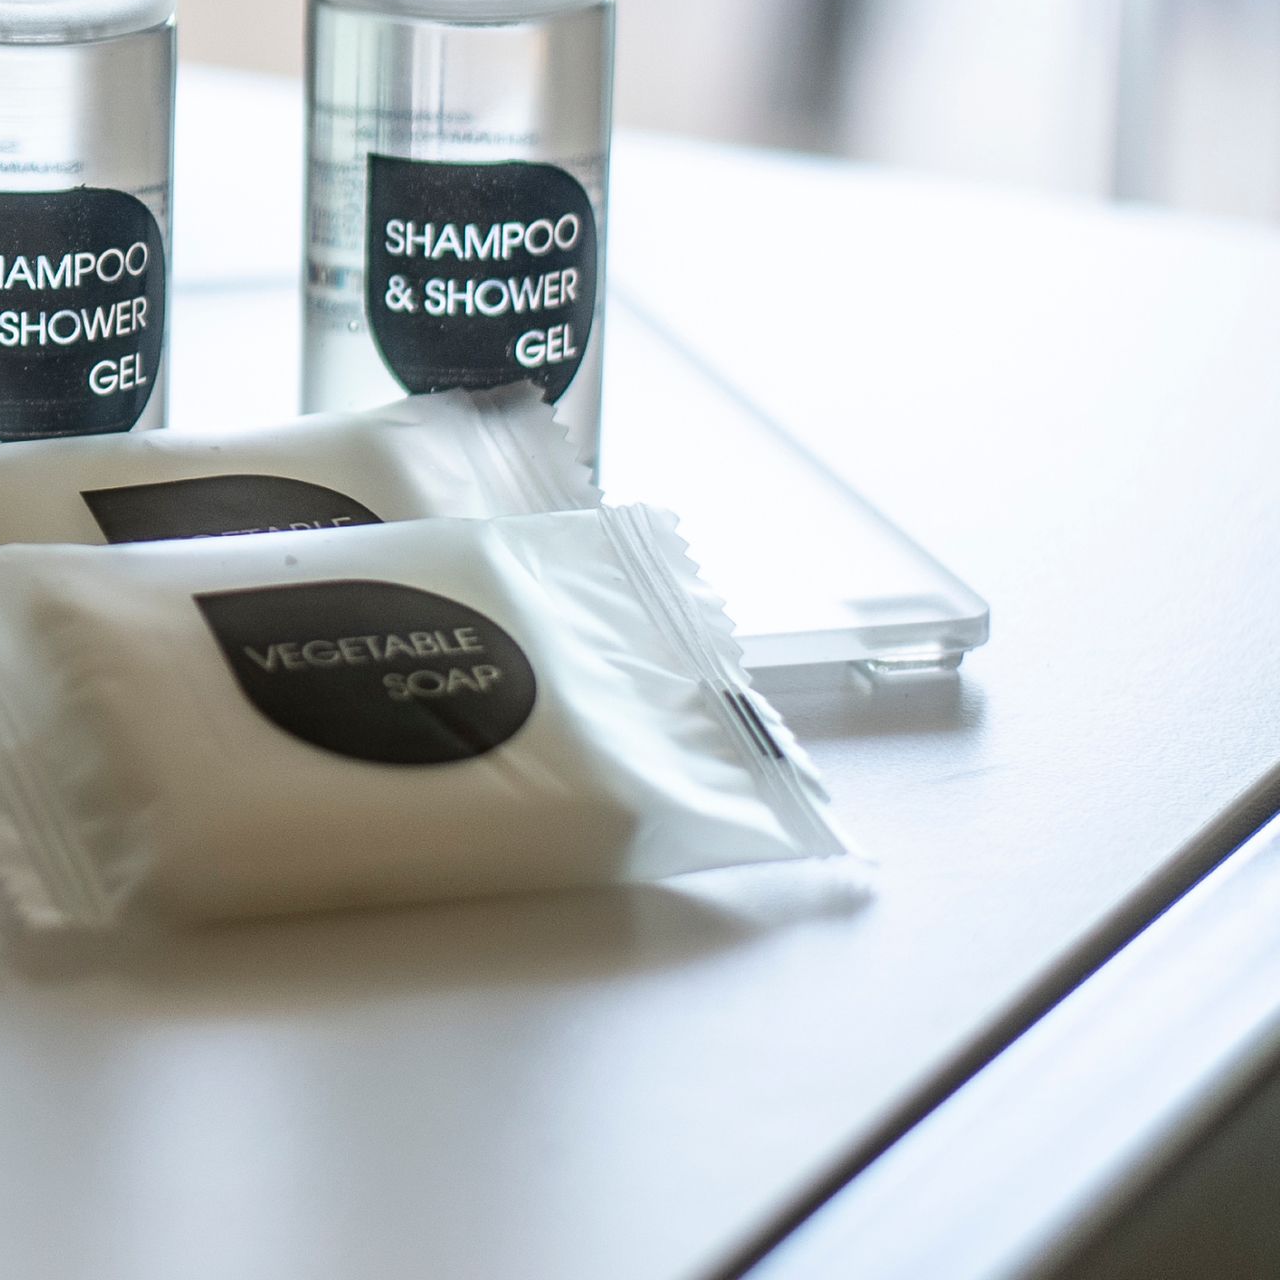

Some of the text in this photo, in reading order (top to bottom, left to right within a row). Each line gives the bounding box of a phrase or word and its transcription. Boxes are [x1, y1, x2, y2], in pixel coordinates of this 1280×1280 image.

[385, 214, 580, 260] SHAMPOO
[385, 279, 417, 313] &
[424, 268, 579, 316] SHOWER
[514, 324, 577, 368] GEL
[88, 352, 147, 395] GEL
[244, 626, 484, 674] VEGETABLE
[382, 663, 503, 703] SOAP
